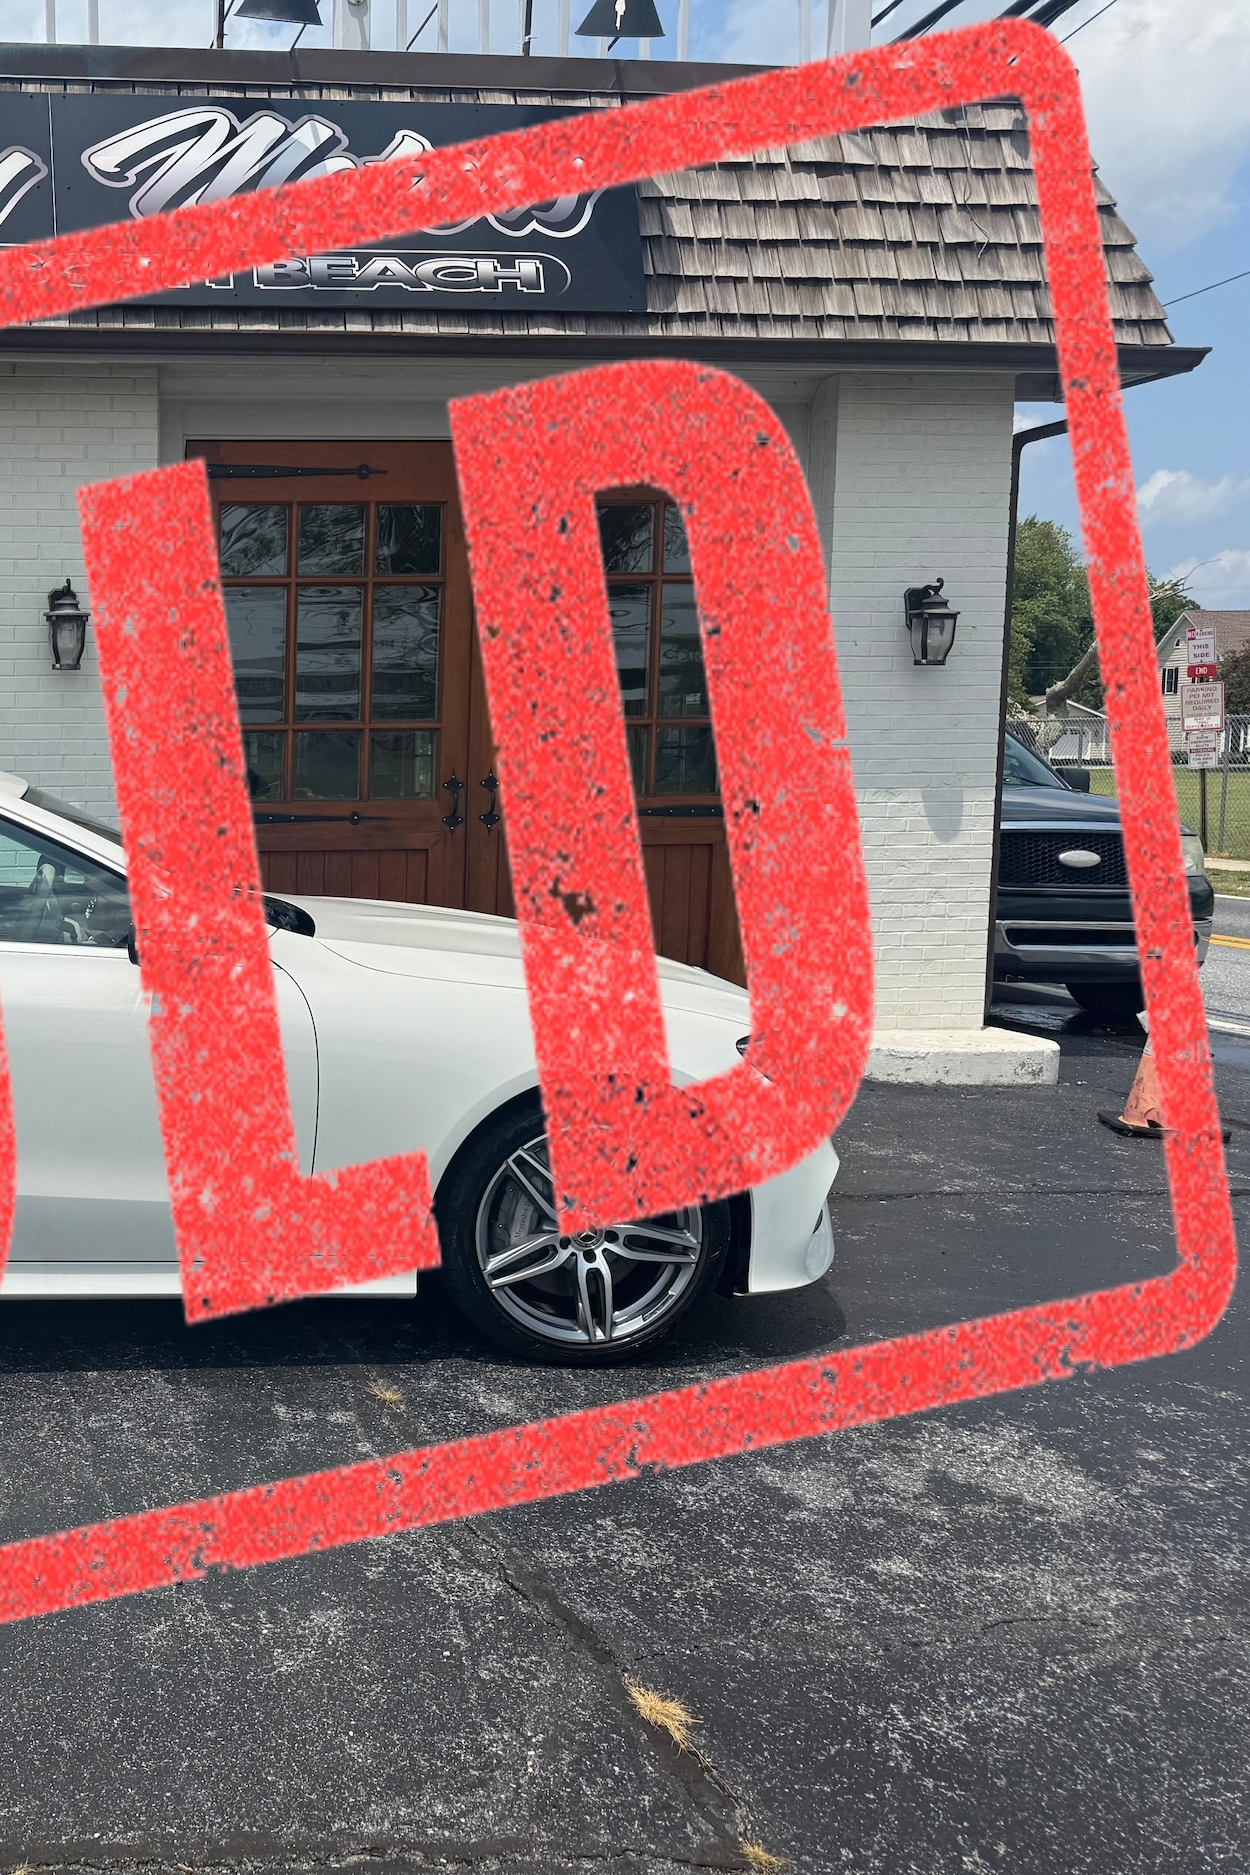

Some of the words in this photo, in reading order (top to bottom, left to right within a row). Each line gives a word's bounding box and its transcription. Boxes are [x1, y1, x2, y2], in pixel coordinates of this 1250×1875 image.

[253, 253, 546, 294] BEACH
[1187, 630, 1196, 639] NO
[1195, 666, 1208, 675] END
[1185, 698, 1220, 706] REQUIRED
